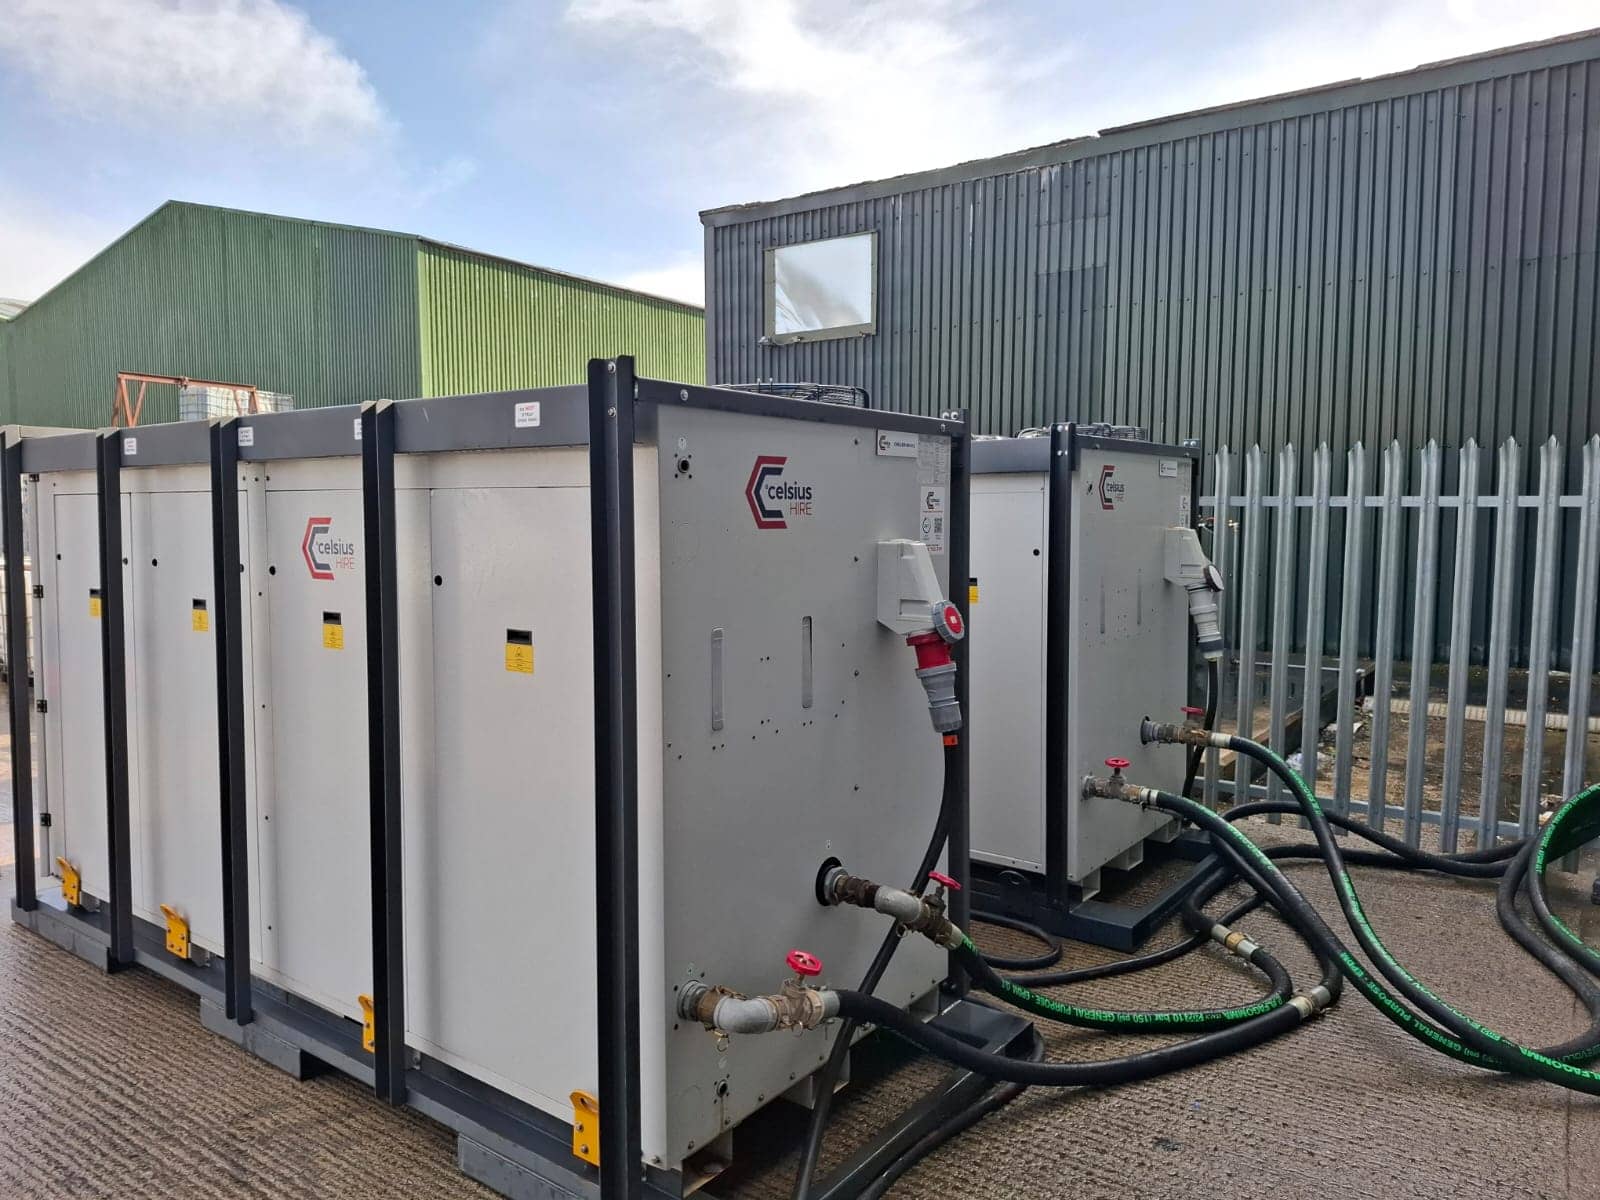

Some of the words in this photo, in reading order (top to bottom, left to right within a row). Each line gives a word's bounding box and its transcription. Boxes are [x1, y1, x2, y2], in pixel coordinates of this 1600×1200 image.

[790, 502, 812, 516] HIRE
[336, 556, 355, 569] HIRE
[1366, 980, 1412, 1022] PURPOSE
[1074, 1008, 1115, 1021] GENERAL
[1414, 1019, 1462, 1051] GENERAL
